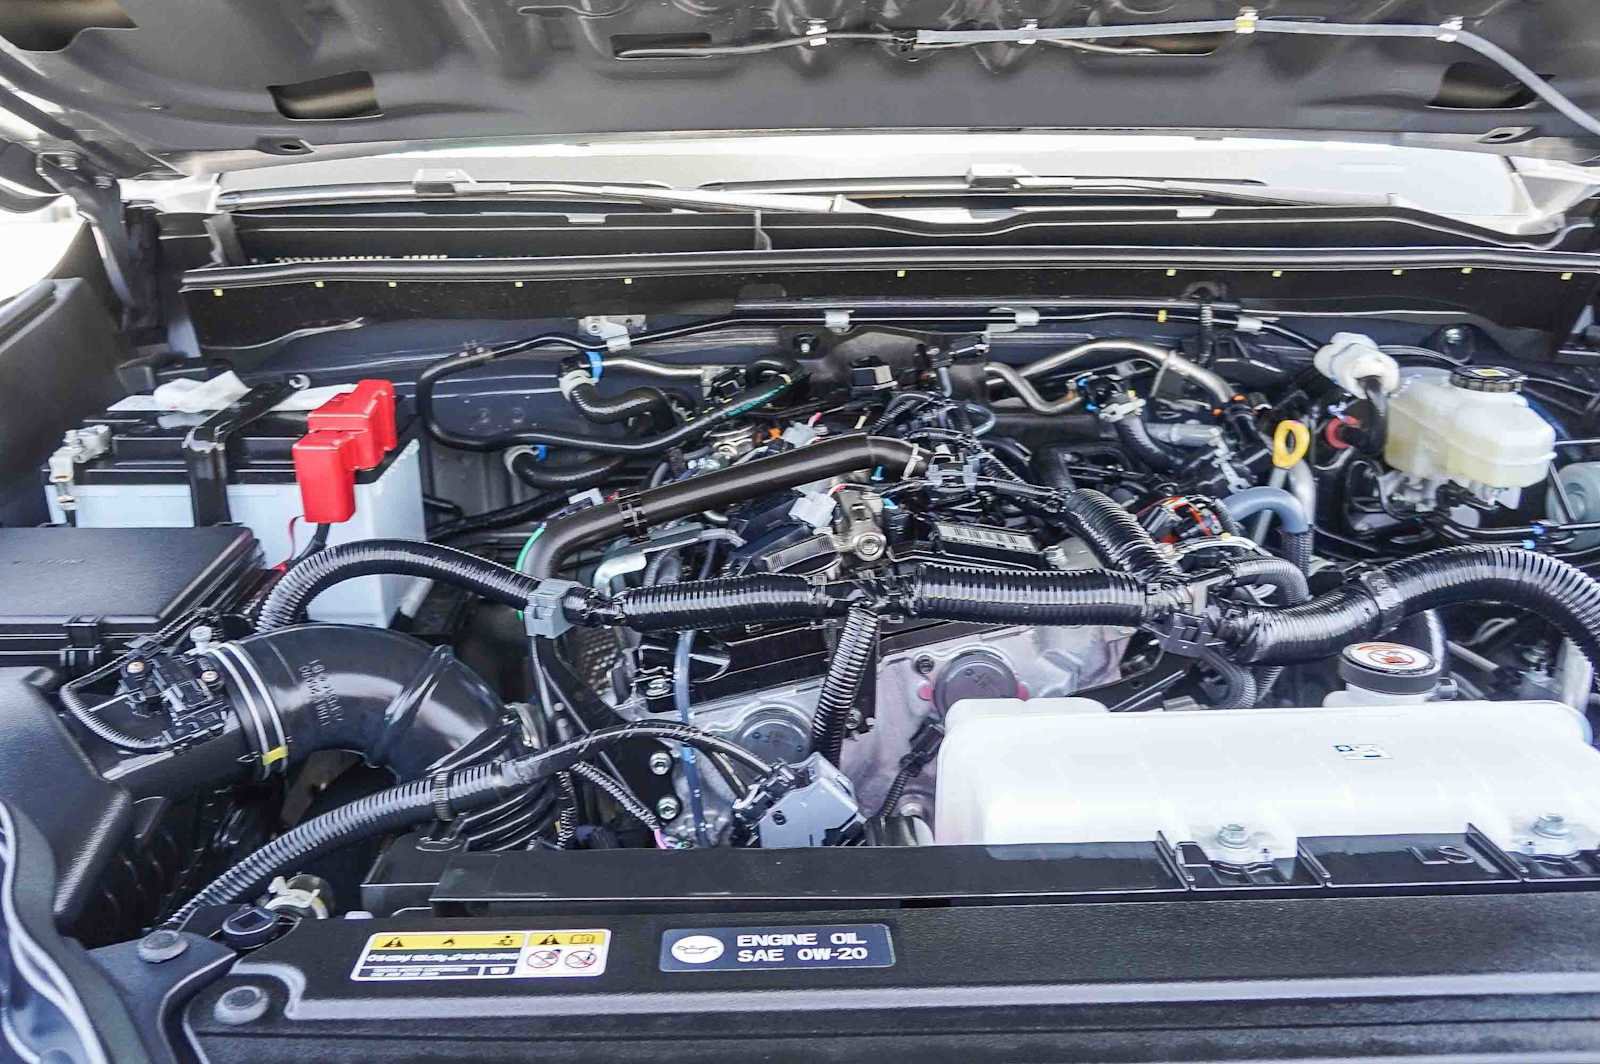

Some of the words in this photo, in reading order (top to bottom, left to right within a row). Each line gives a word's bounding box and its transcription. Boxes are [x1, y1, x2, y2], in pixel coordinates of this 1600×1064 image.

[737, 932, 817, 947] ENGINE
[830, 932, 868, 945] OIL
[736, 948, 785, 963] SAE
[797, 947, 868, 962] 0W-20
